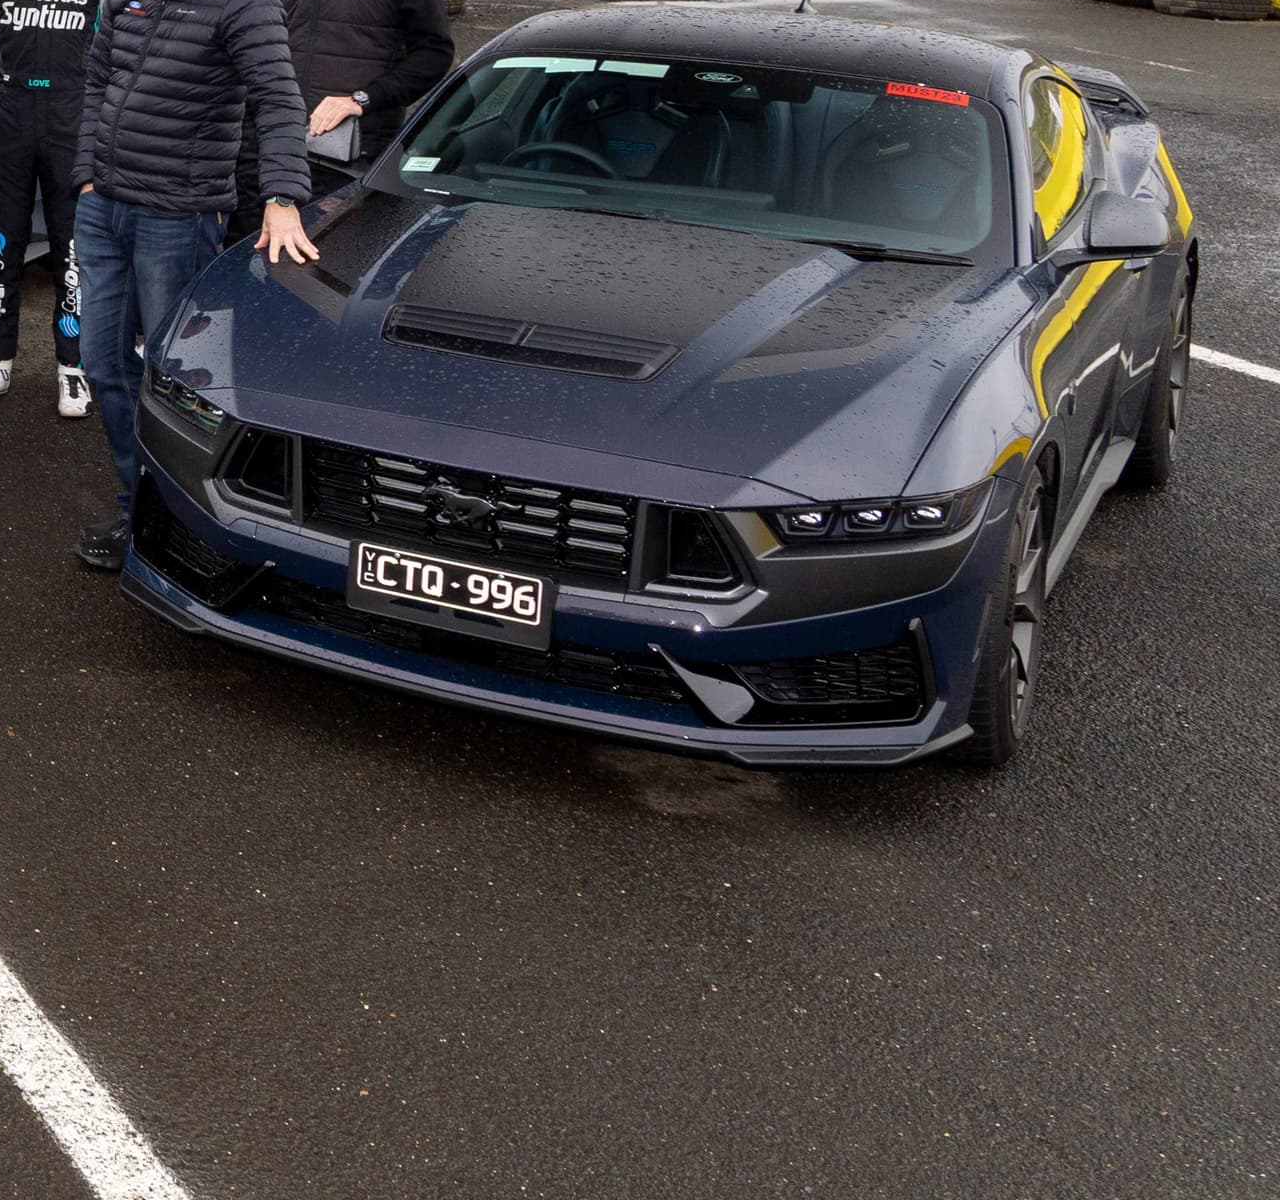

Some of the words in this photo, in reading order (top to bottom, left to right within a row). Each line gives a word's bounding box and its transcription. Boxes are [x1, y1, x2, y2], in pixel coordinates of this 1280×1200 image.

[0, 1, 86, 31] Syntium
[28, 79, 51, 88] LOVE
[701, 73, 737, 83] Ford
[364, 550, 376, 583] VIC
